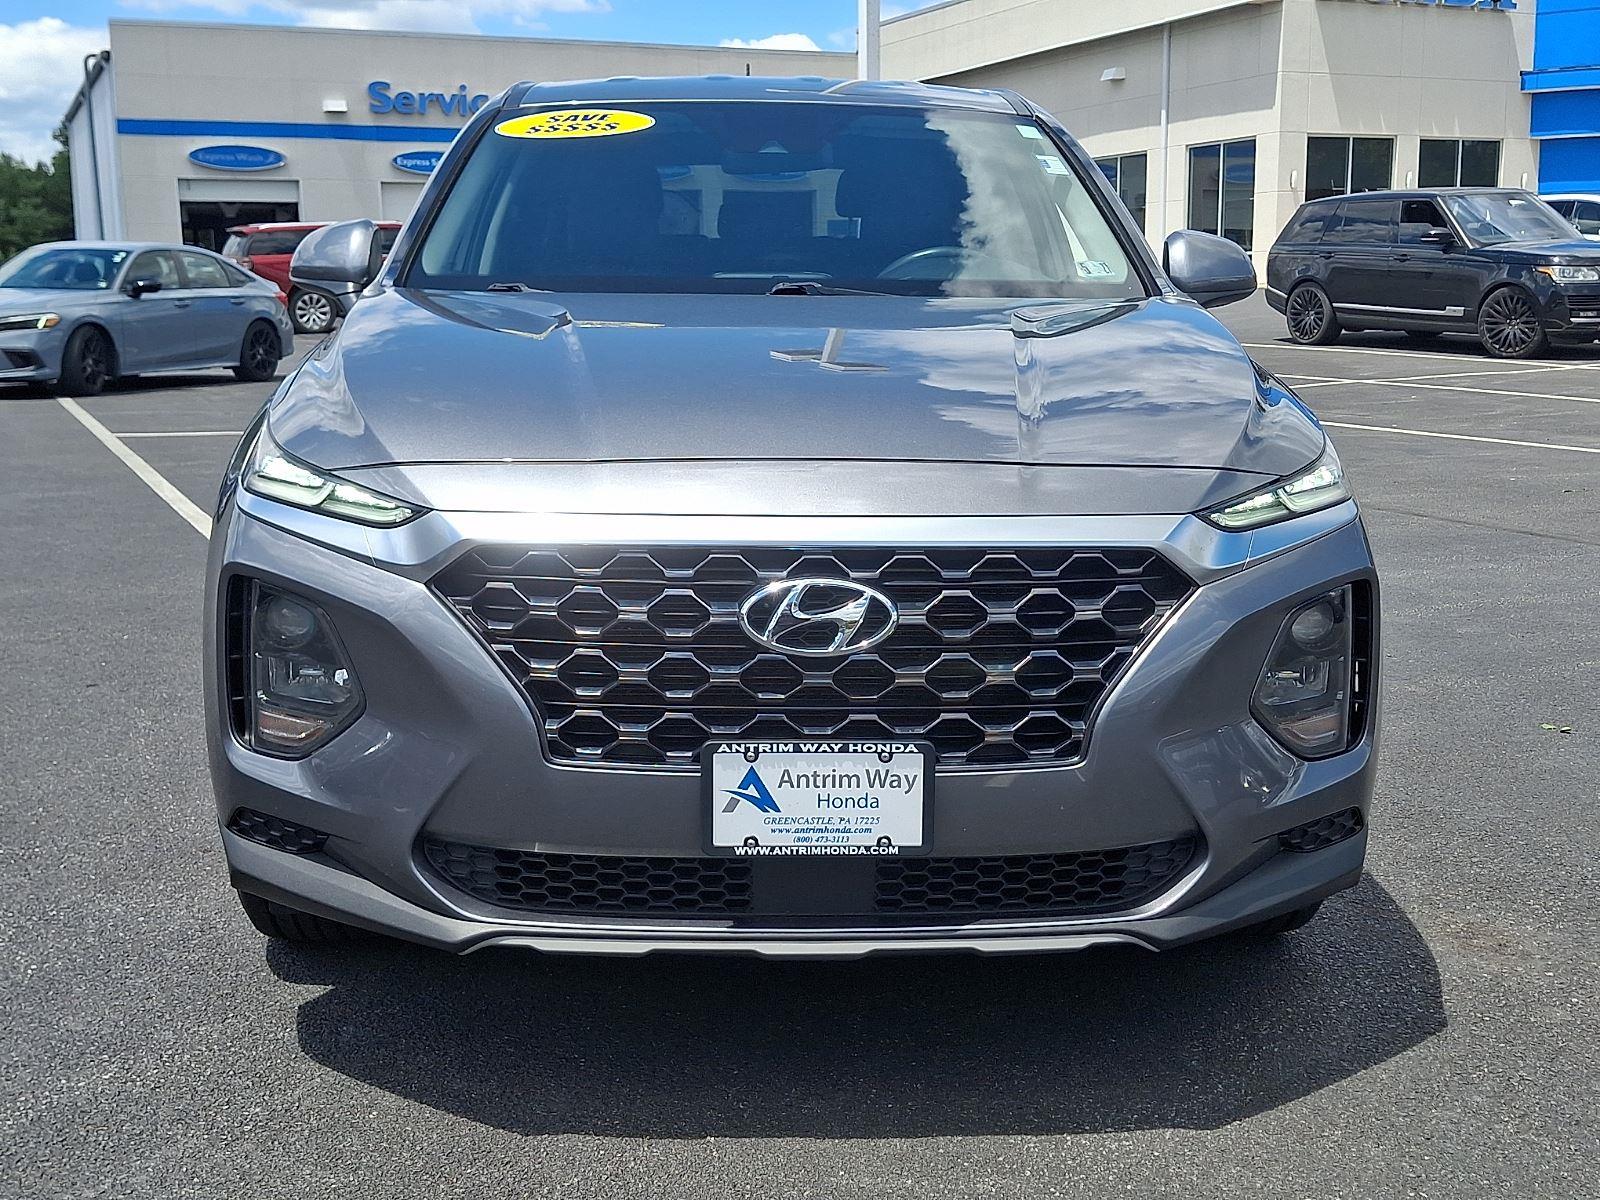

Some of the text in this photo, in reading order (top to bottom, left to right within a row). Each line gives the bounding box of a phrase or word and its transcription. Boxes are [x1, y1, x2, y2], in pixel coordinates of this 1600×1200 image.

[367, 81, 489, 117] Servic
[546, 113, 613, 123] SAVE
[396, 156, 430, 168] Express
[717, 743, 919, 753] ANTRIM WAY HONDA
[777, 768, 918, 794] Antrim Way
[817, 792, 880, 809] Honda
[763, 816, 881, 826] GREENCASTLE, PA 17225
[770, 825, 873, 834] www.antrimhonda.com
[793, 835, 850, 844] (800) 473-3113
[734, 846, 899, 855] WWW.ANTRIMHONDA.COM
